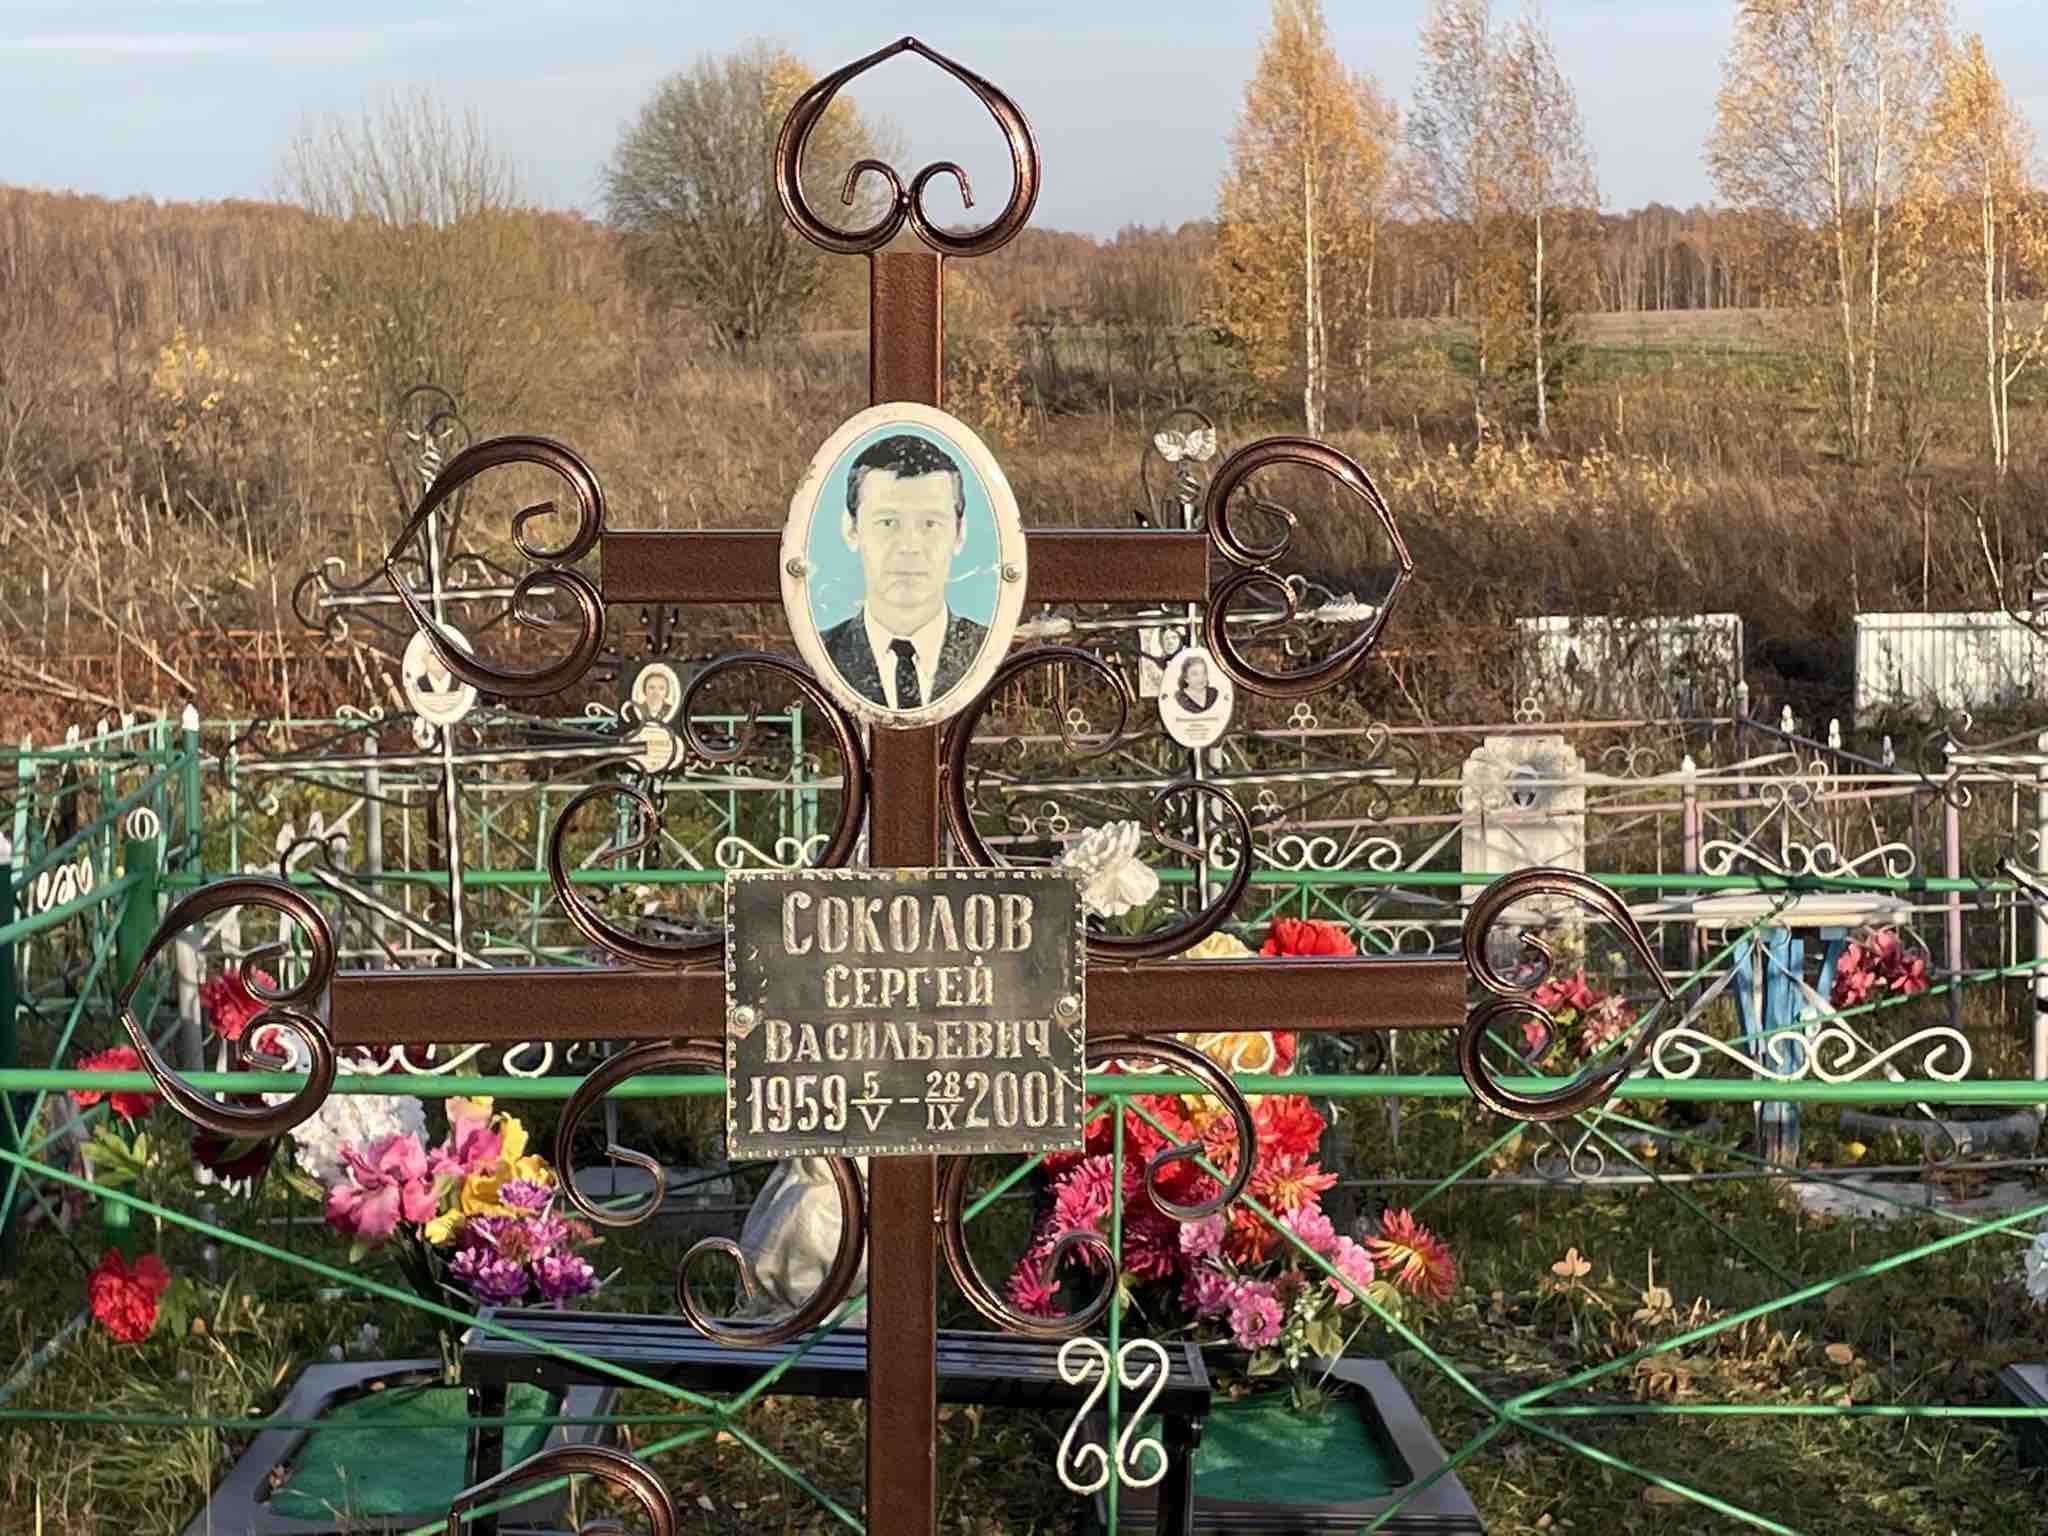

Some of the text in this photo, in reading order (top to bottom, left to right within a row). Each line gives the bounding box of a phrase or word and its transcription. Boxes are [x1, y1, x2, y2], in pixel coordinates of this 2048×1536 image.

[781, 890, 1034, 955] СОКОЛОВ
[823, 956, 994, 1009] СЕРГЕЙ
[763, 1018, 1051, 1064] ВАСИЛЬЕВИЧ
[746, 1073, 848, 1134] 1959
[964, 1070, 1069, 1129] 2001
